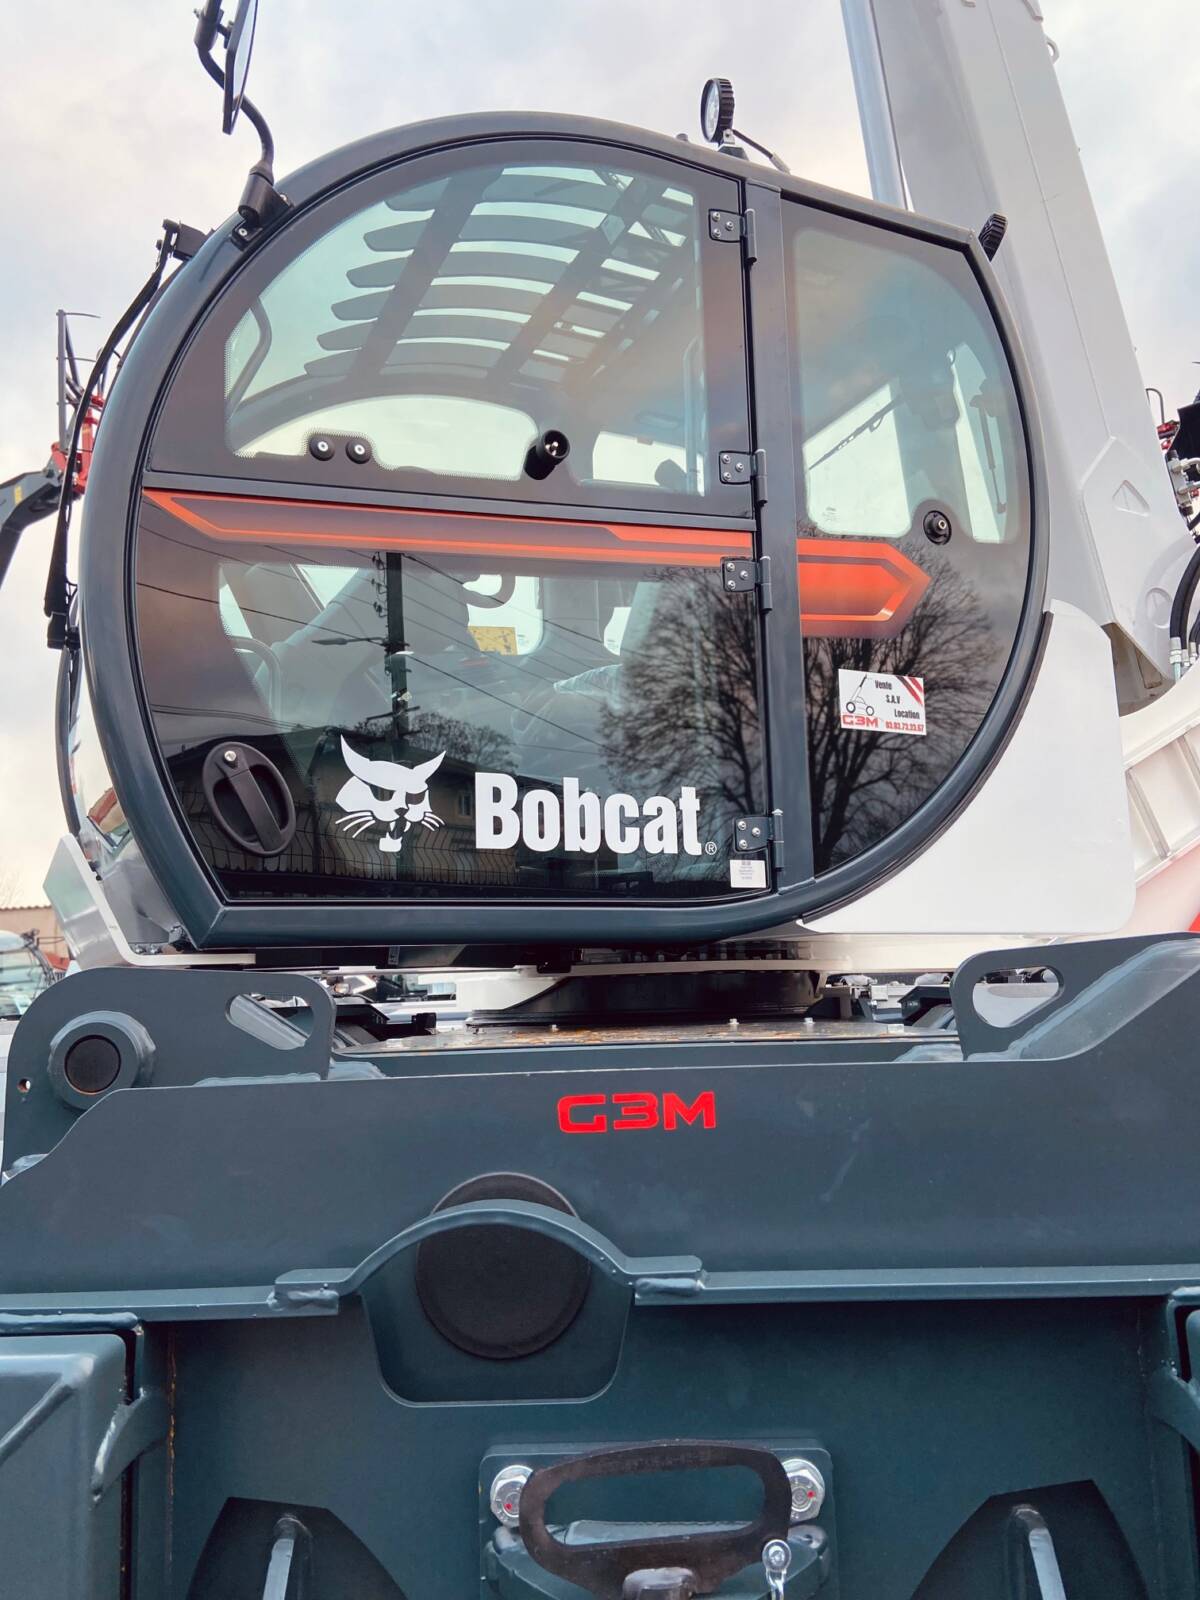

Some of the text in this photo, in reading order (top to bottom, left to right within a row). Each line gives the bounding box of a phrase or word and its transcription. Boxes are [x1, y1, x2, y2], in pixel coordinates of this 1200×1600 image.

[874, 680, 892, 690] Vente
[894, 708, 920, 719] Location
[842, 714, 879, 728] G3M
[557, 1091, 717, 1134] G3M
